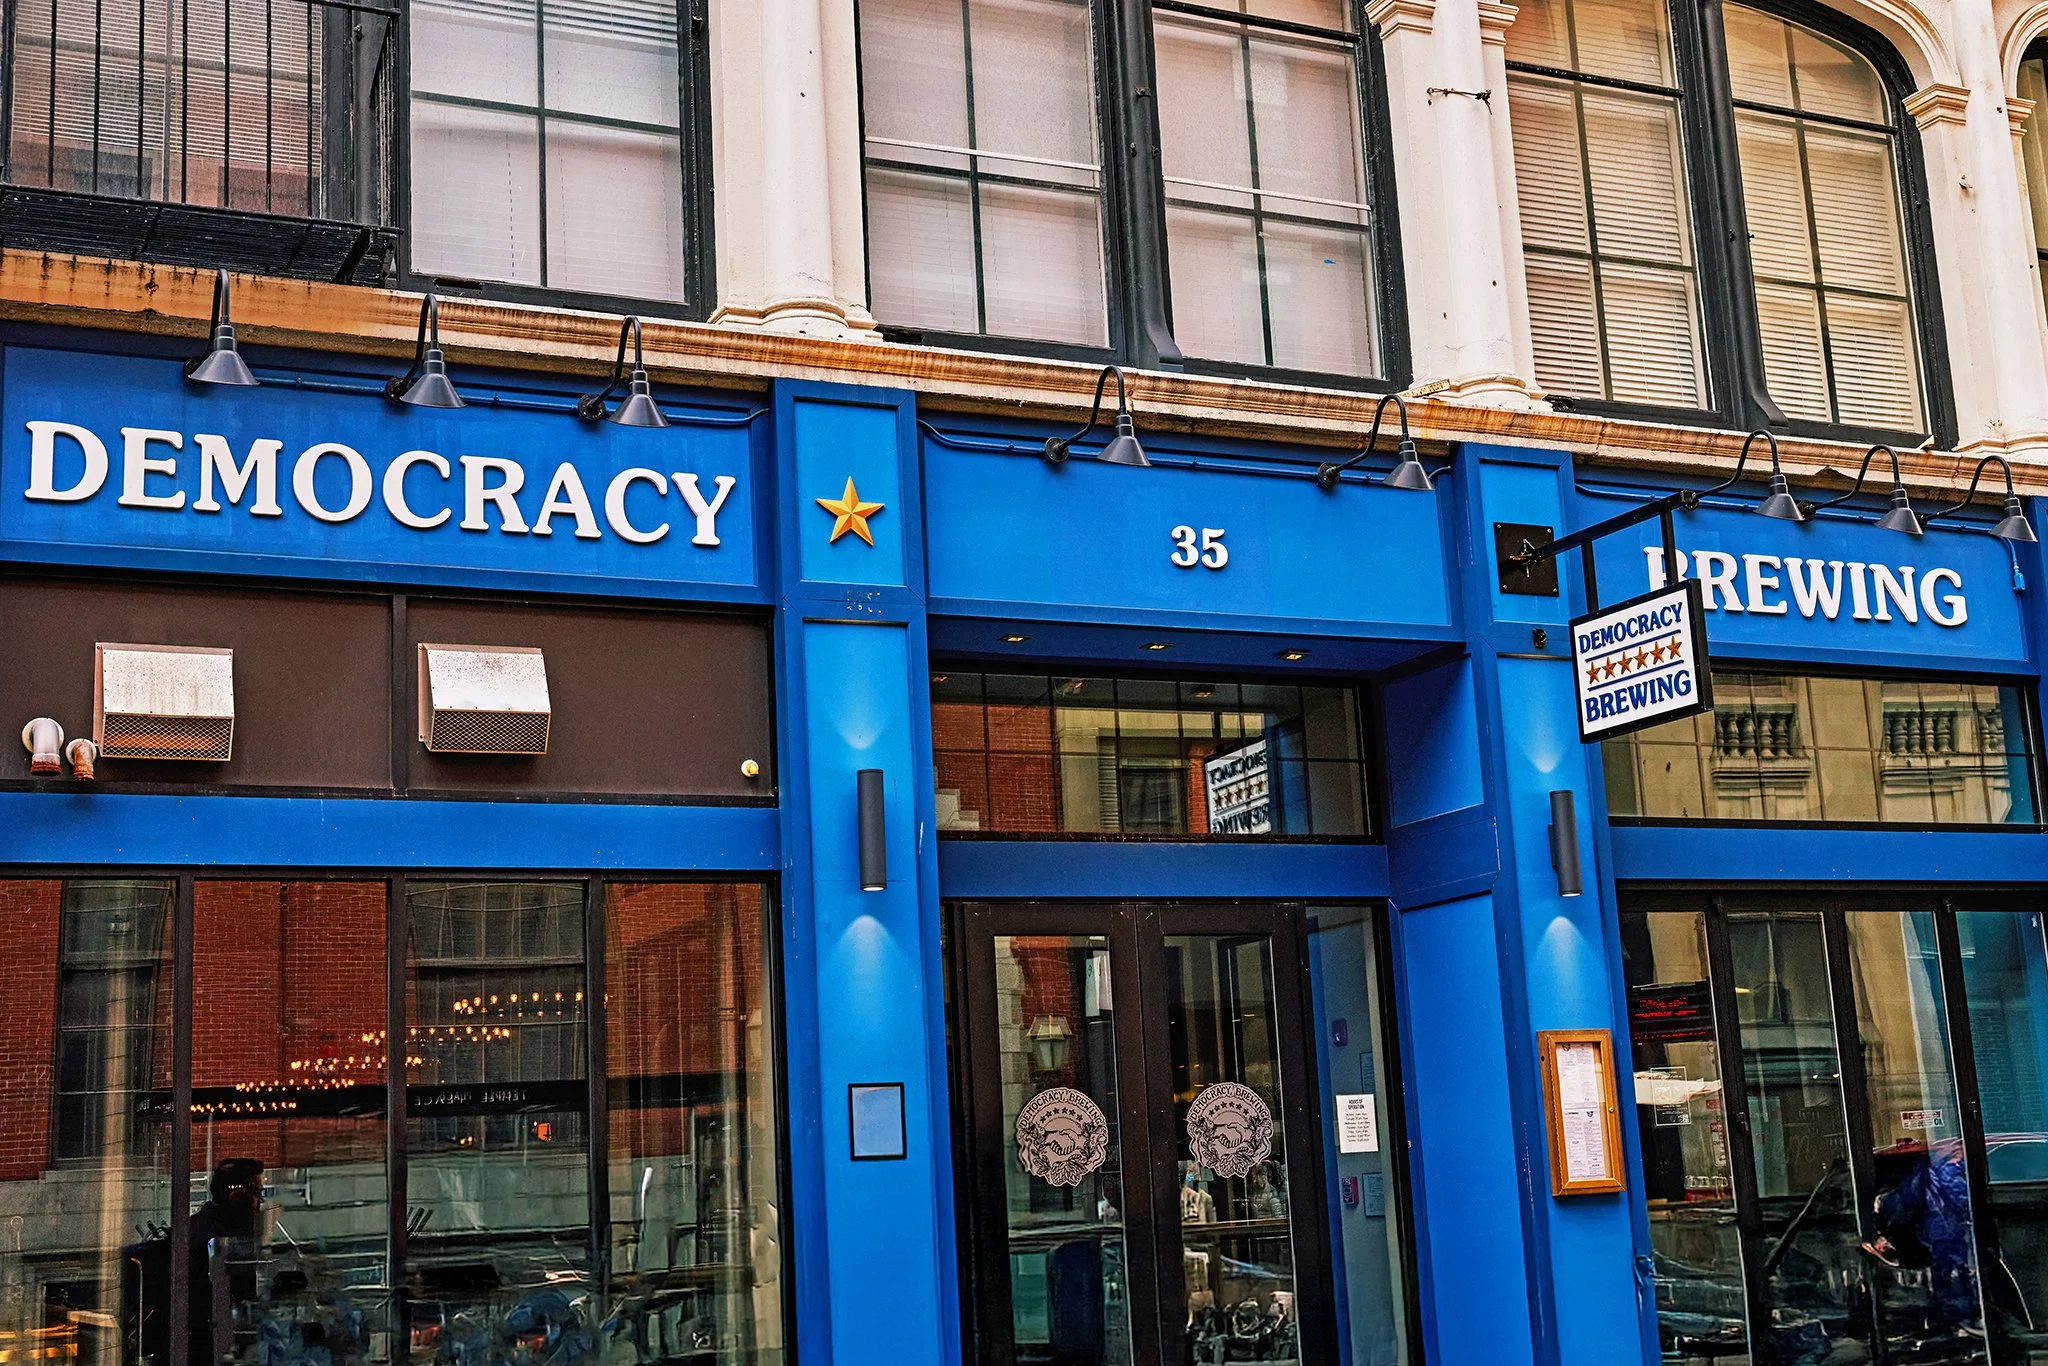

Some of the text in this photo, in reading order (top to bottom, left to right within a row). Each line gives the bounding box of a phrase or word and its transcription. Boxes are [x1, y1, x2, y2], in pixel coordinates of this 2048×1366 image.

[24, 420, 736, 546] DEMOCRACY
[1171, 525, 1228, 568] 35
[1579, 602, 1682, 654] DEMOCRACY
[1585, 669, 1692, 723] BREWING
[1020, 1091, 1103, 1128] DEMOCRACY BREWING
[1191, 1086, 1232, 1121] DEMOCRACY
[1235, 1086, 1268, 1119] BREWING
